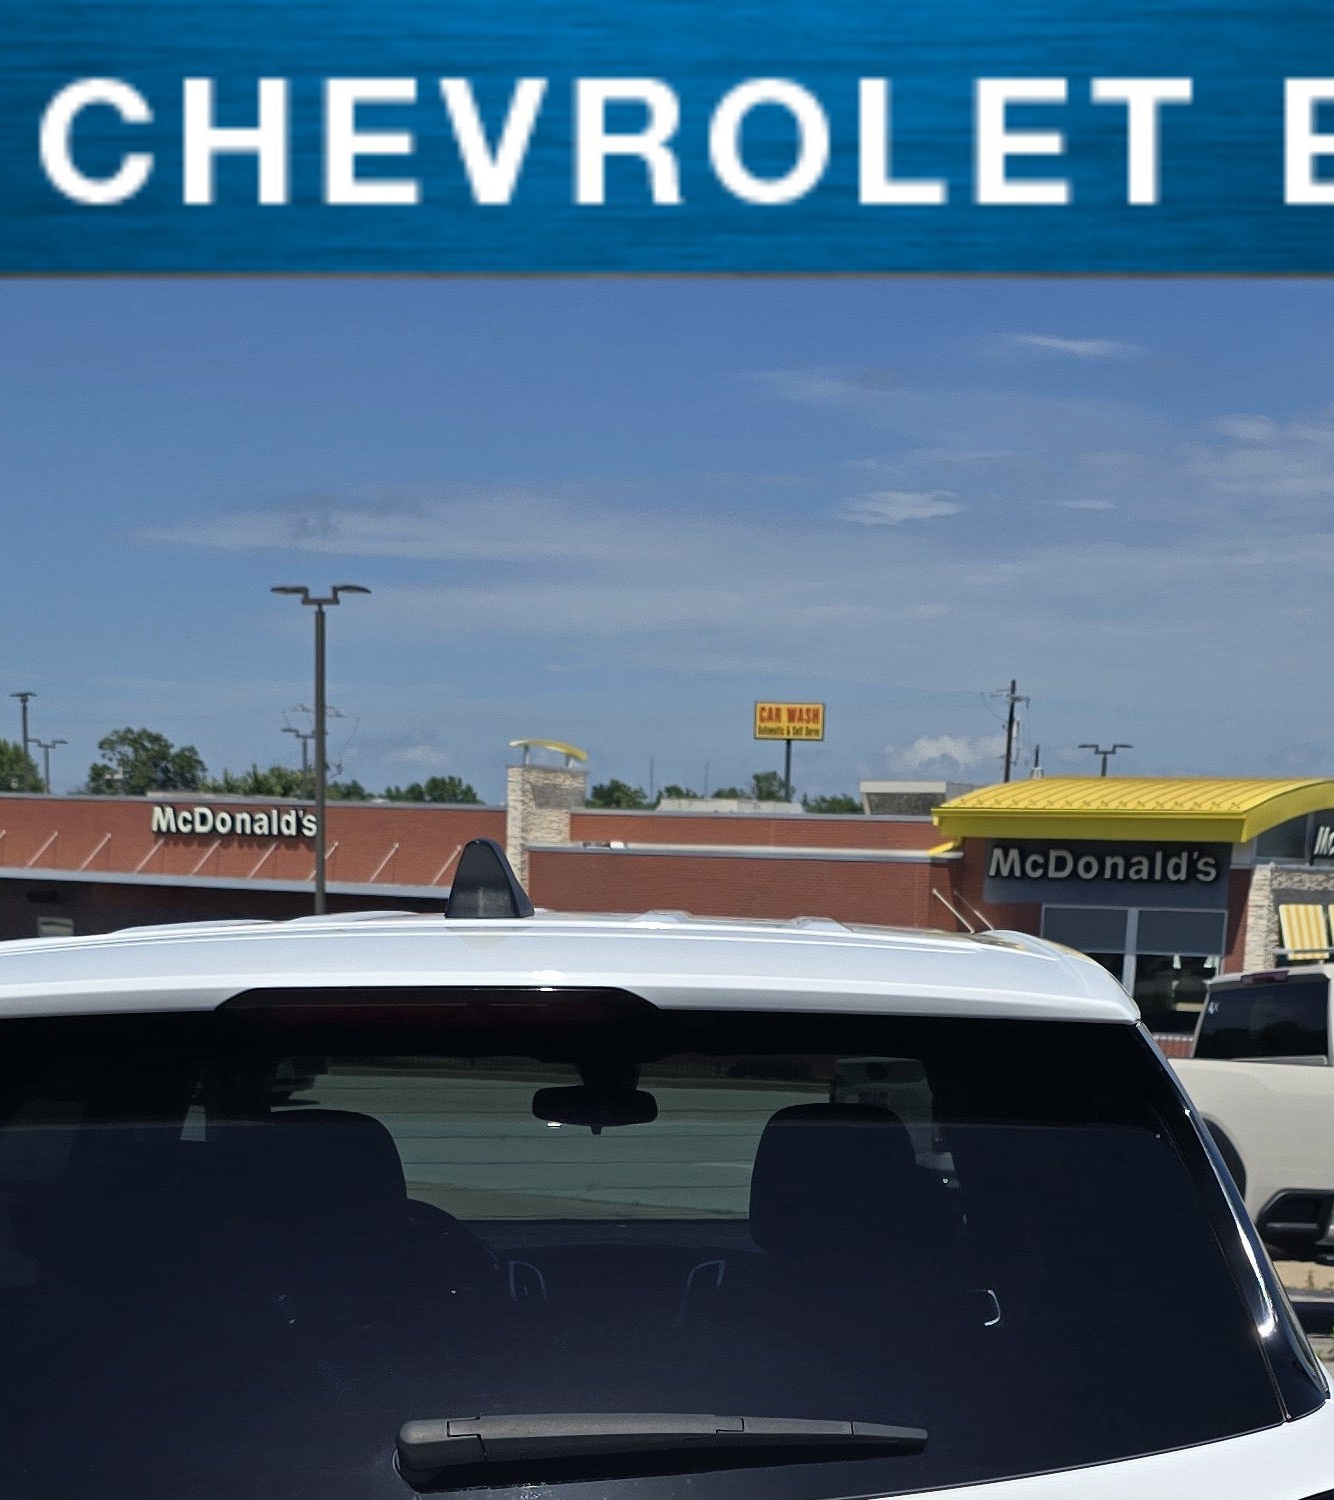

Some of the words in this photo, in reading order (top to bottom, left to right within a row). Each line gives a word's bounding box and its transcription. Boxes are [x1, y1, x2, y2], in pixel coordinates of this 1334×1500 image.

[759, 706, 782, 723] CAR
[787, 707, 820, 724] WASH
[151, 804, 318, 838] McDonald's
[988, 847, 1218, 882] McDonald's
